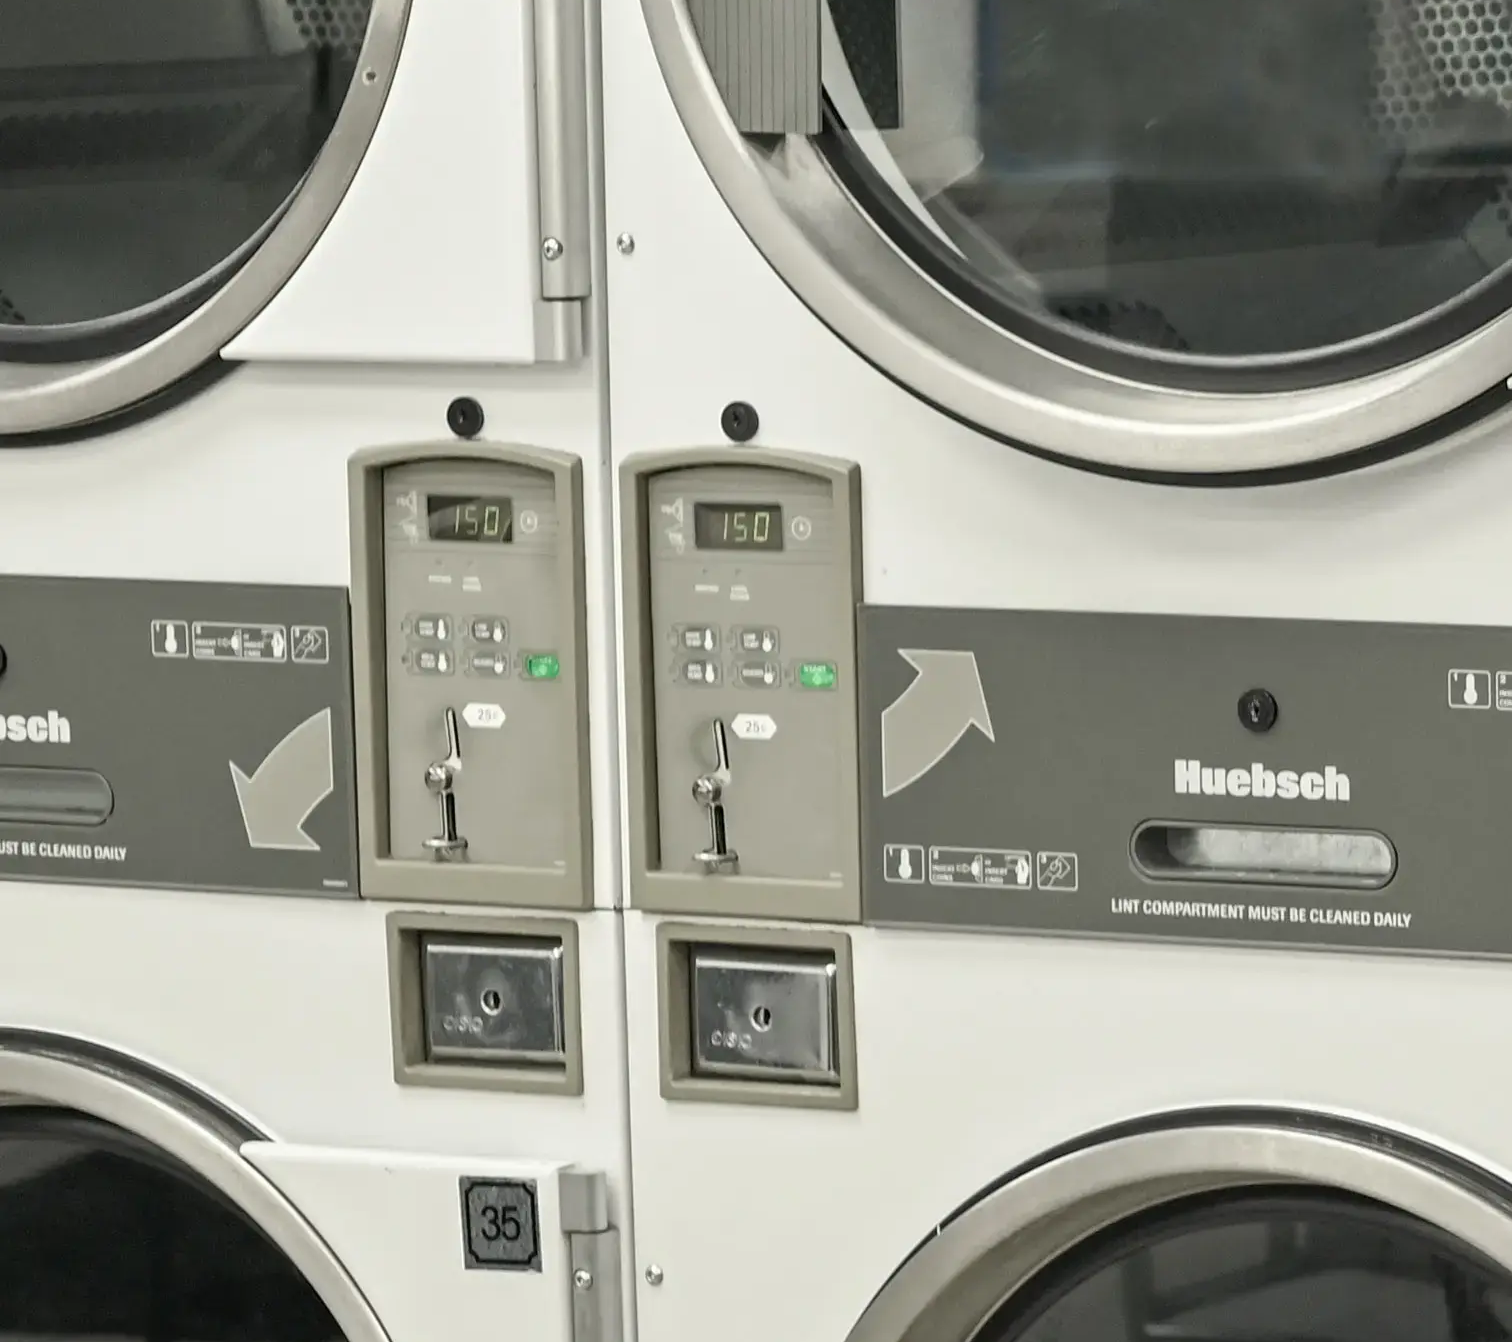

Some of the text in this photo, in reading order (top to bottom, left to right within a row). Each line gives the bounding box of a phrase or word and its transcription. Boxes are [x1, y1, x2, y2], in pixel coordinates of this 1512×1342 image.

[455, 505, 500, 536] 150
[722, 512, 770, 542] 150
[1174, 759, 1350, 802] Huebsch
[0, 840, 127, 861] UST BE CLEANED DAILY
[1111, 897, 1412, 929] LINT COMPARTMENT MUST BE CLEANED DAILY
[480, 1205, 521, 1241] 35
